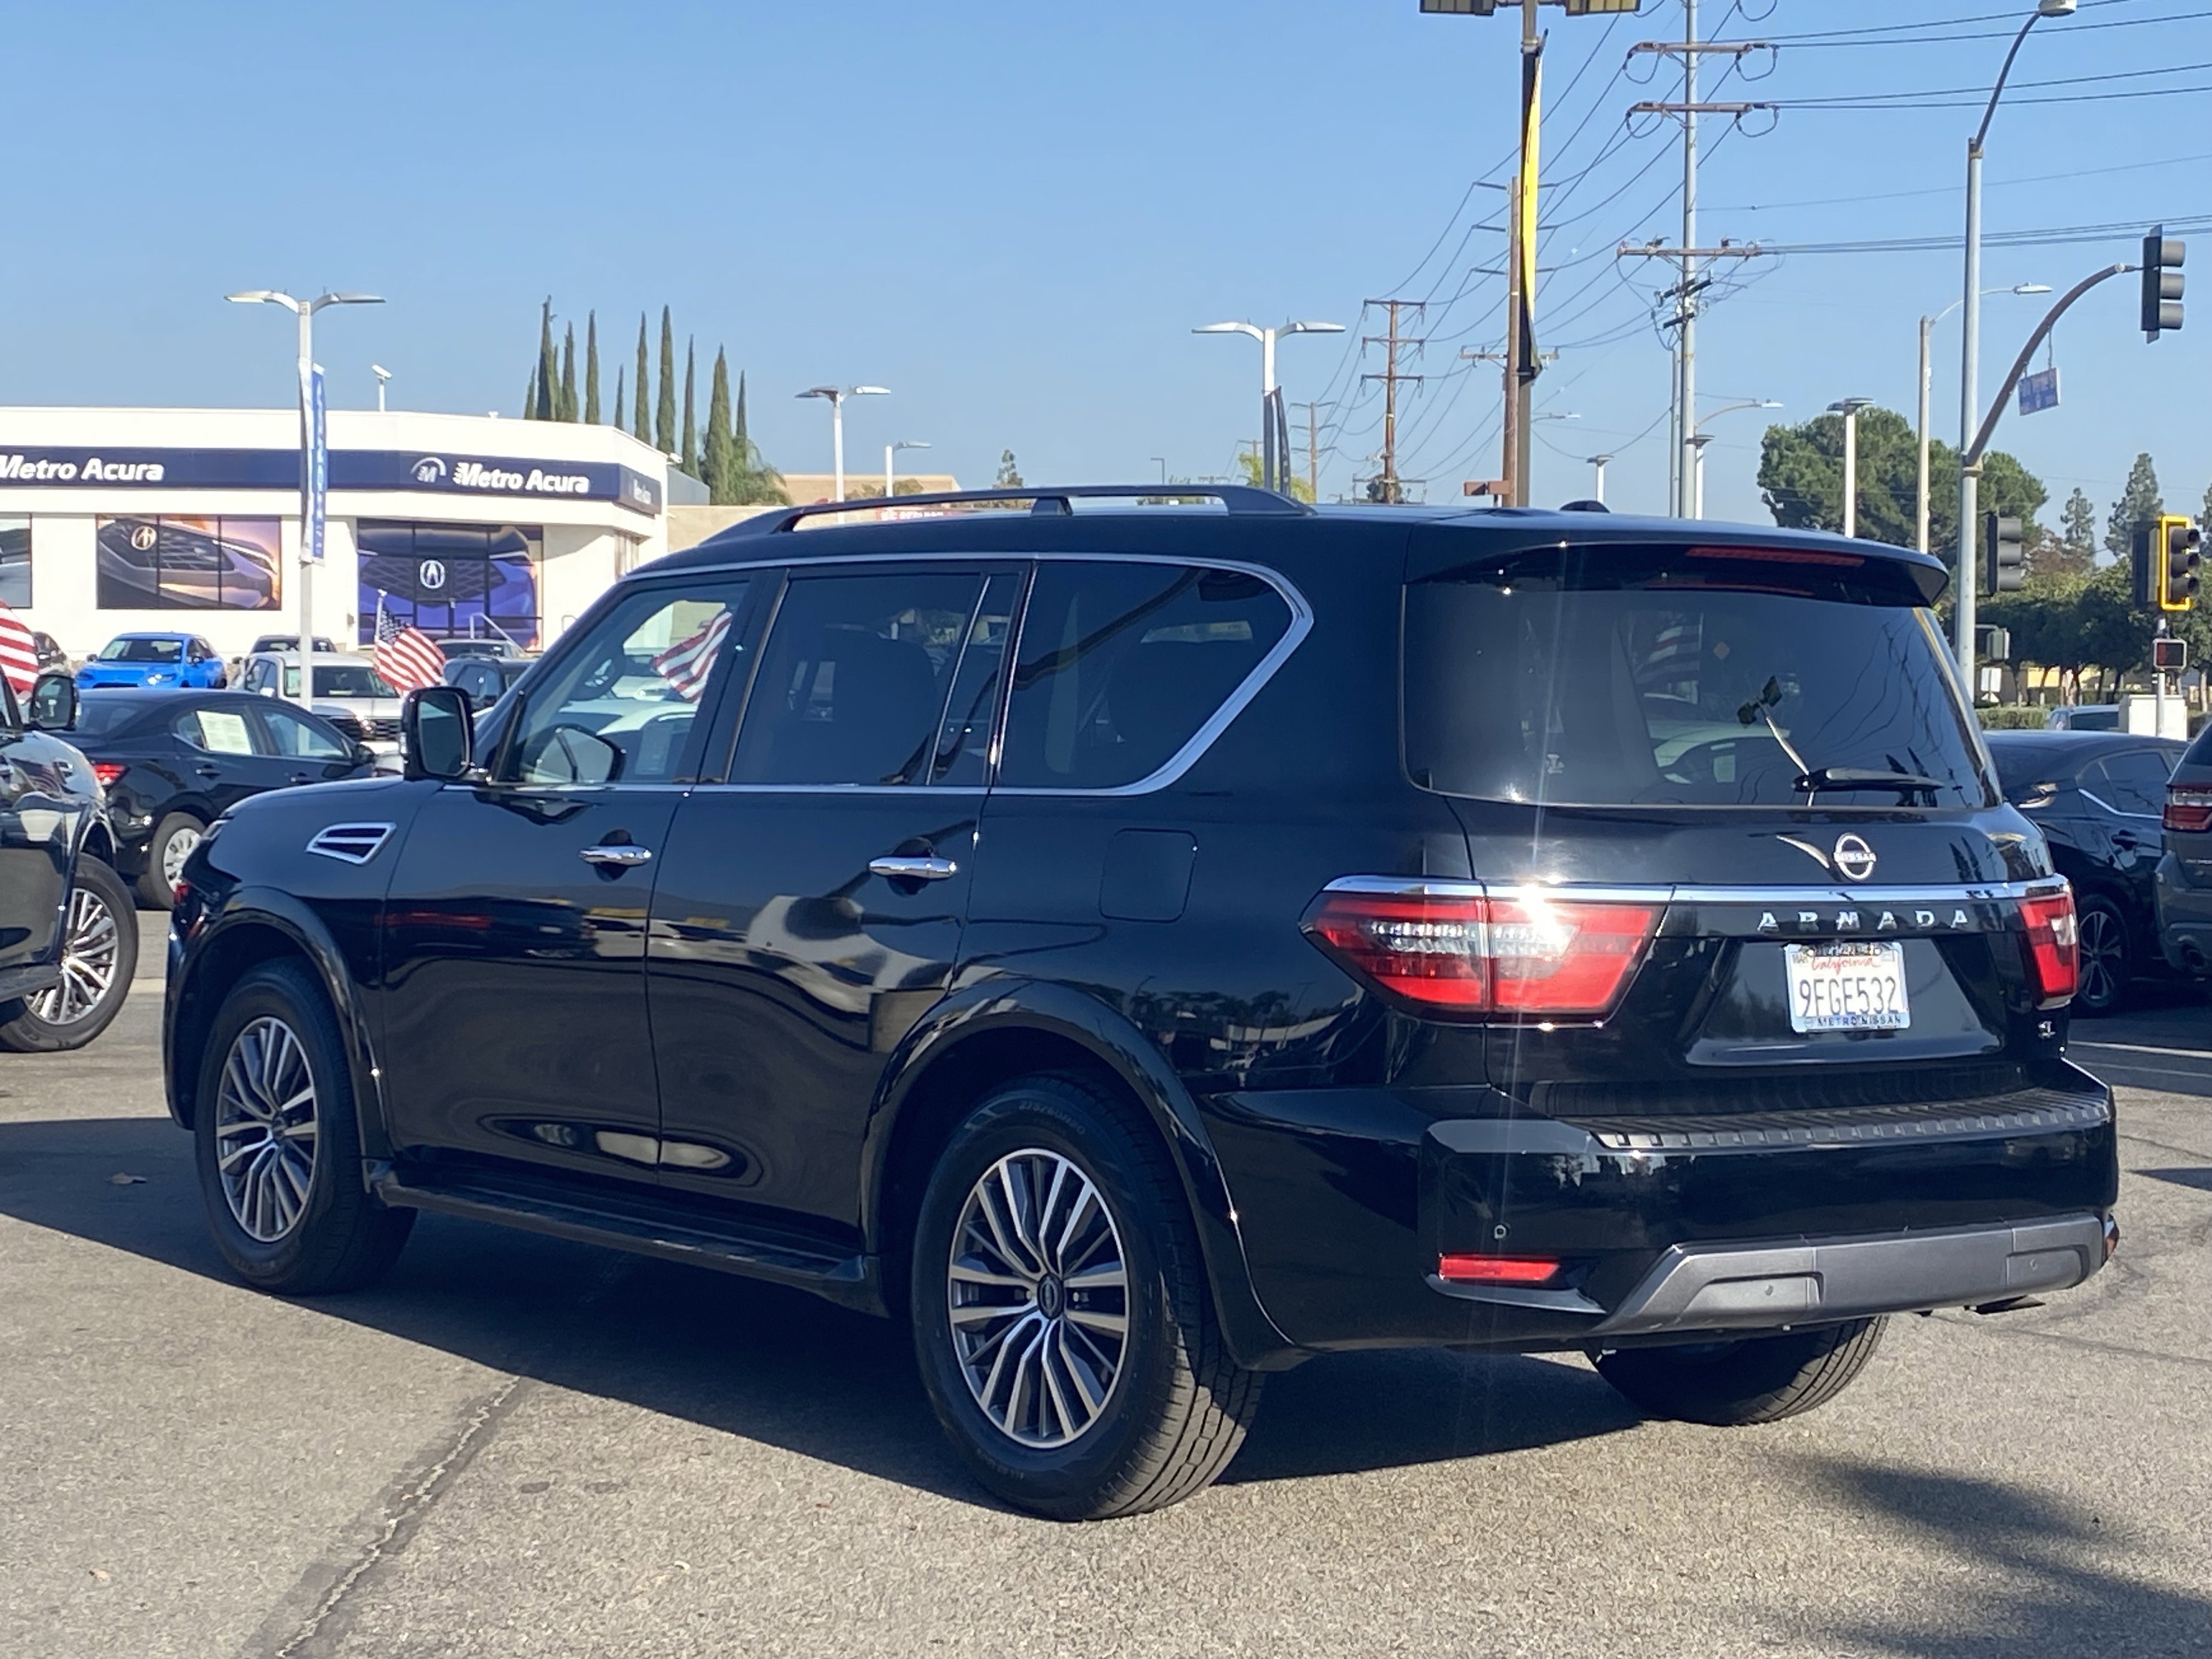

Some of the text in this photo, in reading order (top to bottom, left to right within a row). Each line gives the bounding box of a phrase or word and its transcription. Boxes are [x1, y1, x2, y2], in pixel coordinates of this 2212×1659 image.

[0, 455, 164, 481] Metro Acura
[453, 462, 590, 493] Metro Acura
[1757, 909, 1969, 932] ARMADA
[1812, 957, 1881, 975] California
[1799, 976, 1899, 1017] 9FGE532
[1817, 1014, 1901, 1026] METRO NISSAN
